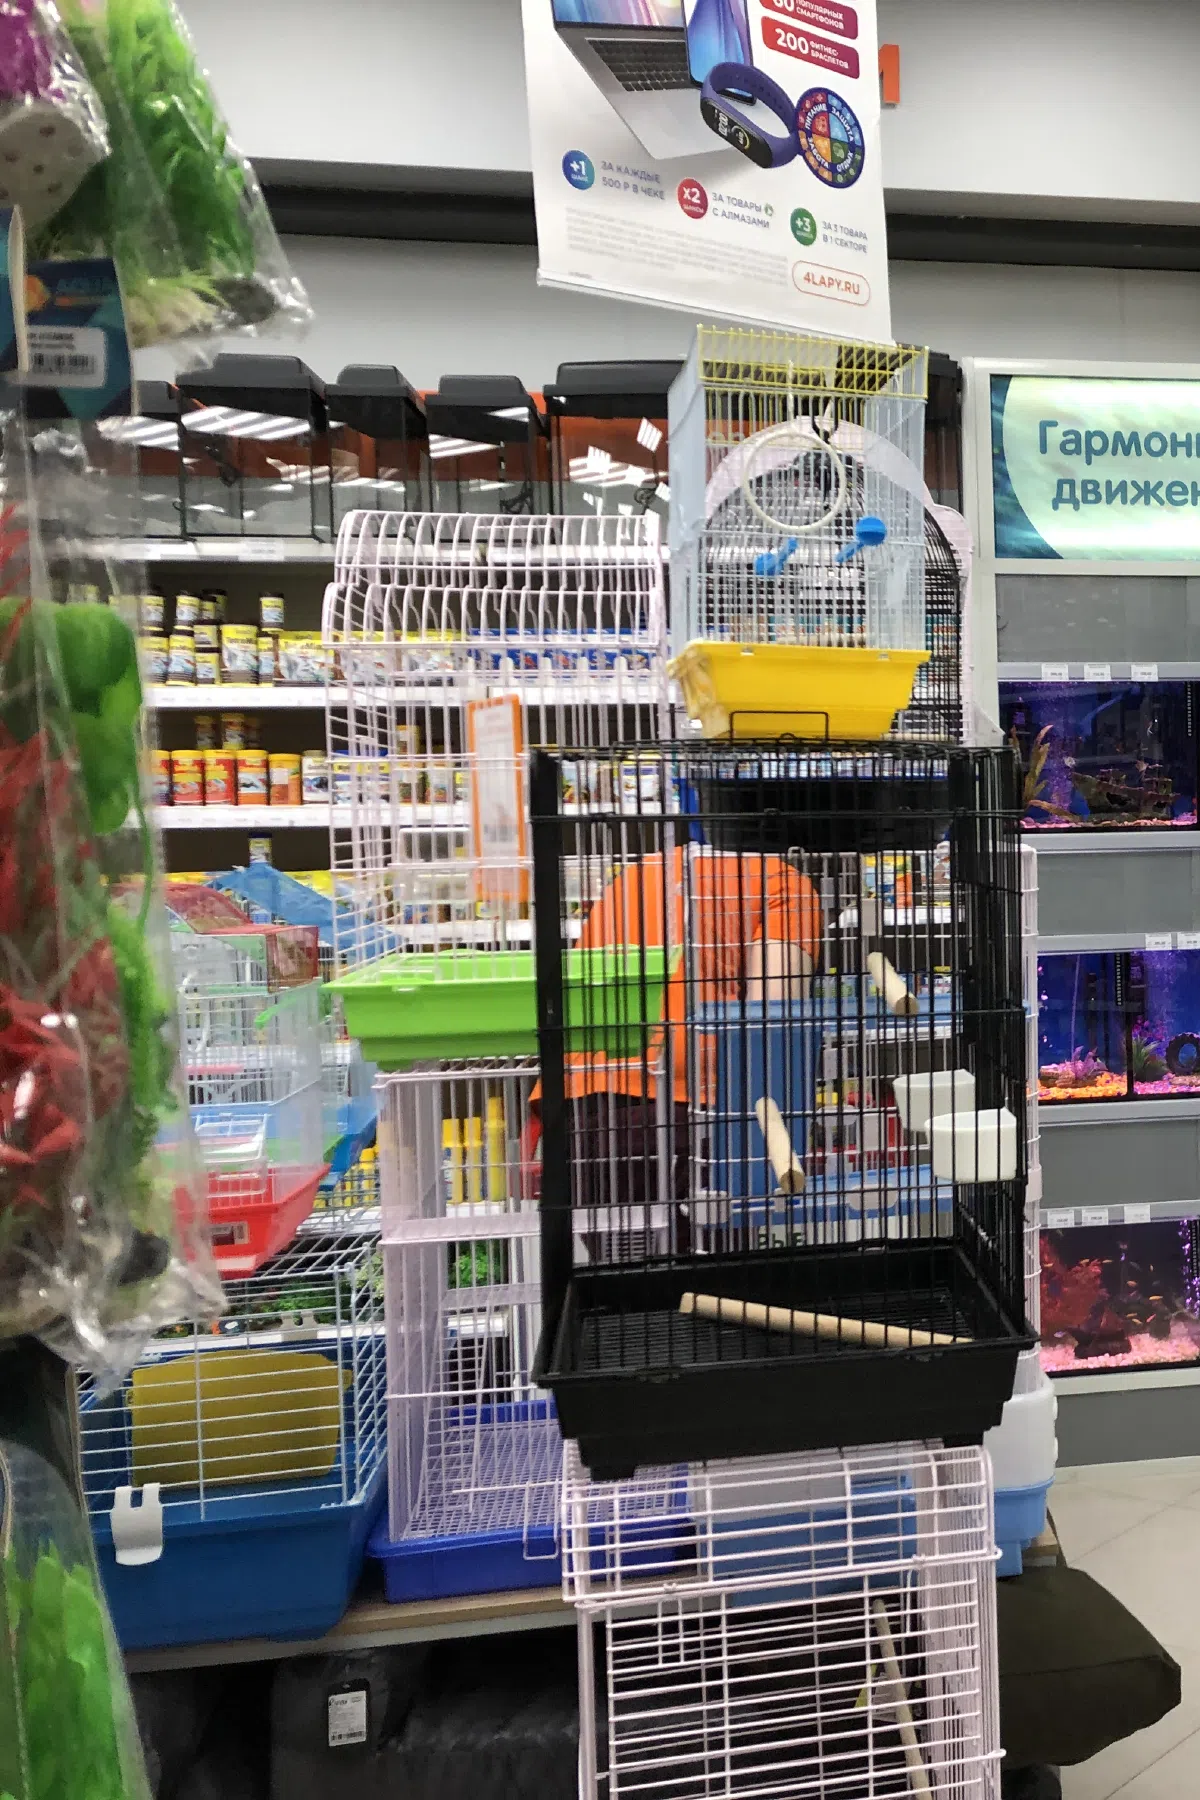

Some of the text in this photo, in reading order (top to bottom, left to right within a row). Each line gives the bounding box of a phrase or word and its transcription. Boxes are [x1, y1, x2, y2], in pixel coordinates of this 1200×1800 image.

[796, 7, 845, 30] СМАРТФОНОВ
[775, 28, 809, 54] 200
[810, 49, 849, 69] БРАСЛЕТОВ
[805, 102, 827, 130] ПИТАНИЕ
[831, 107, 855, 142] ЗАЩИТА
[808, 137, 830, 168] ЗАБОТА
[836, 151, 854, 172] ОТДЫХ
[569, 160, 586, 176] +1
[601, 161, 661, 184] ЗА КАЖДЫЕ
[602, 176, 622, 189] 500
[632, 183, 639, 193] В
[641, 185, 665, 201] ЧЕКЕ
[712, 192, 762, 213] ЗА ТОВАРЫ
[712, 207, 770, 229] С АЛМАЗАМИ
[795, 217, 811, 232] +3
[822, 220, 832, 230] ЗА
[840, 225, 868, 241] ТОВАРА
[822, 233, 828, 242] В
[835, 238, 868, 254] СЕКТОРЕ
[803, 271, 860, 295] 4LAPY.RU
